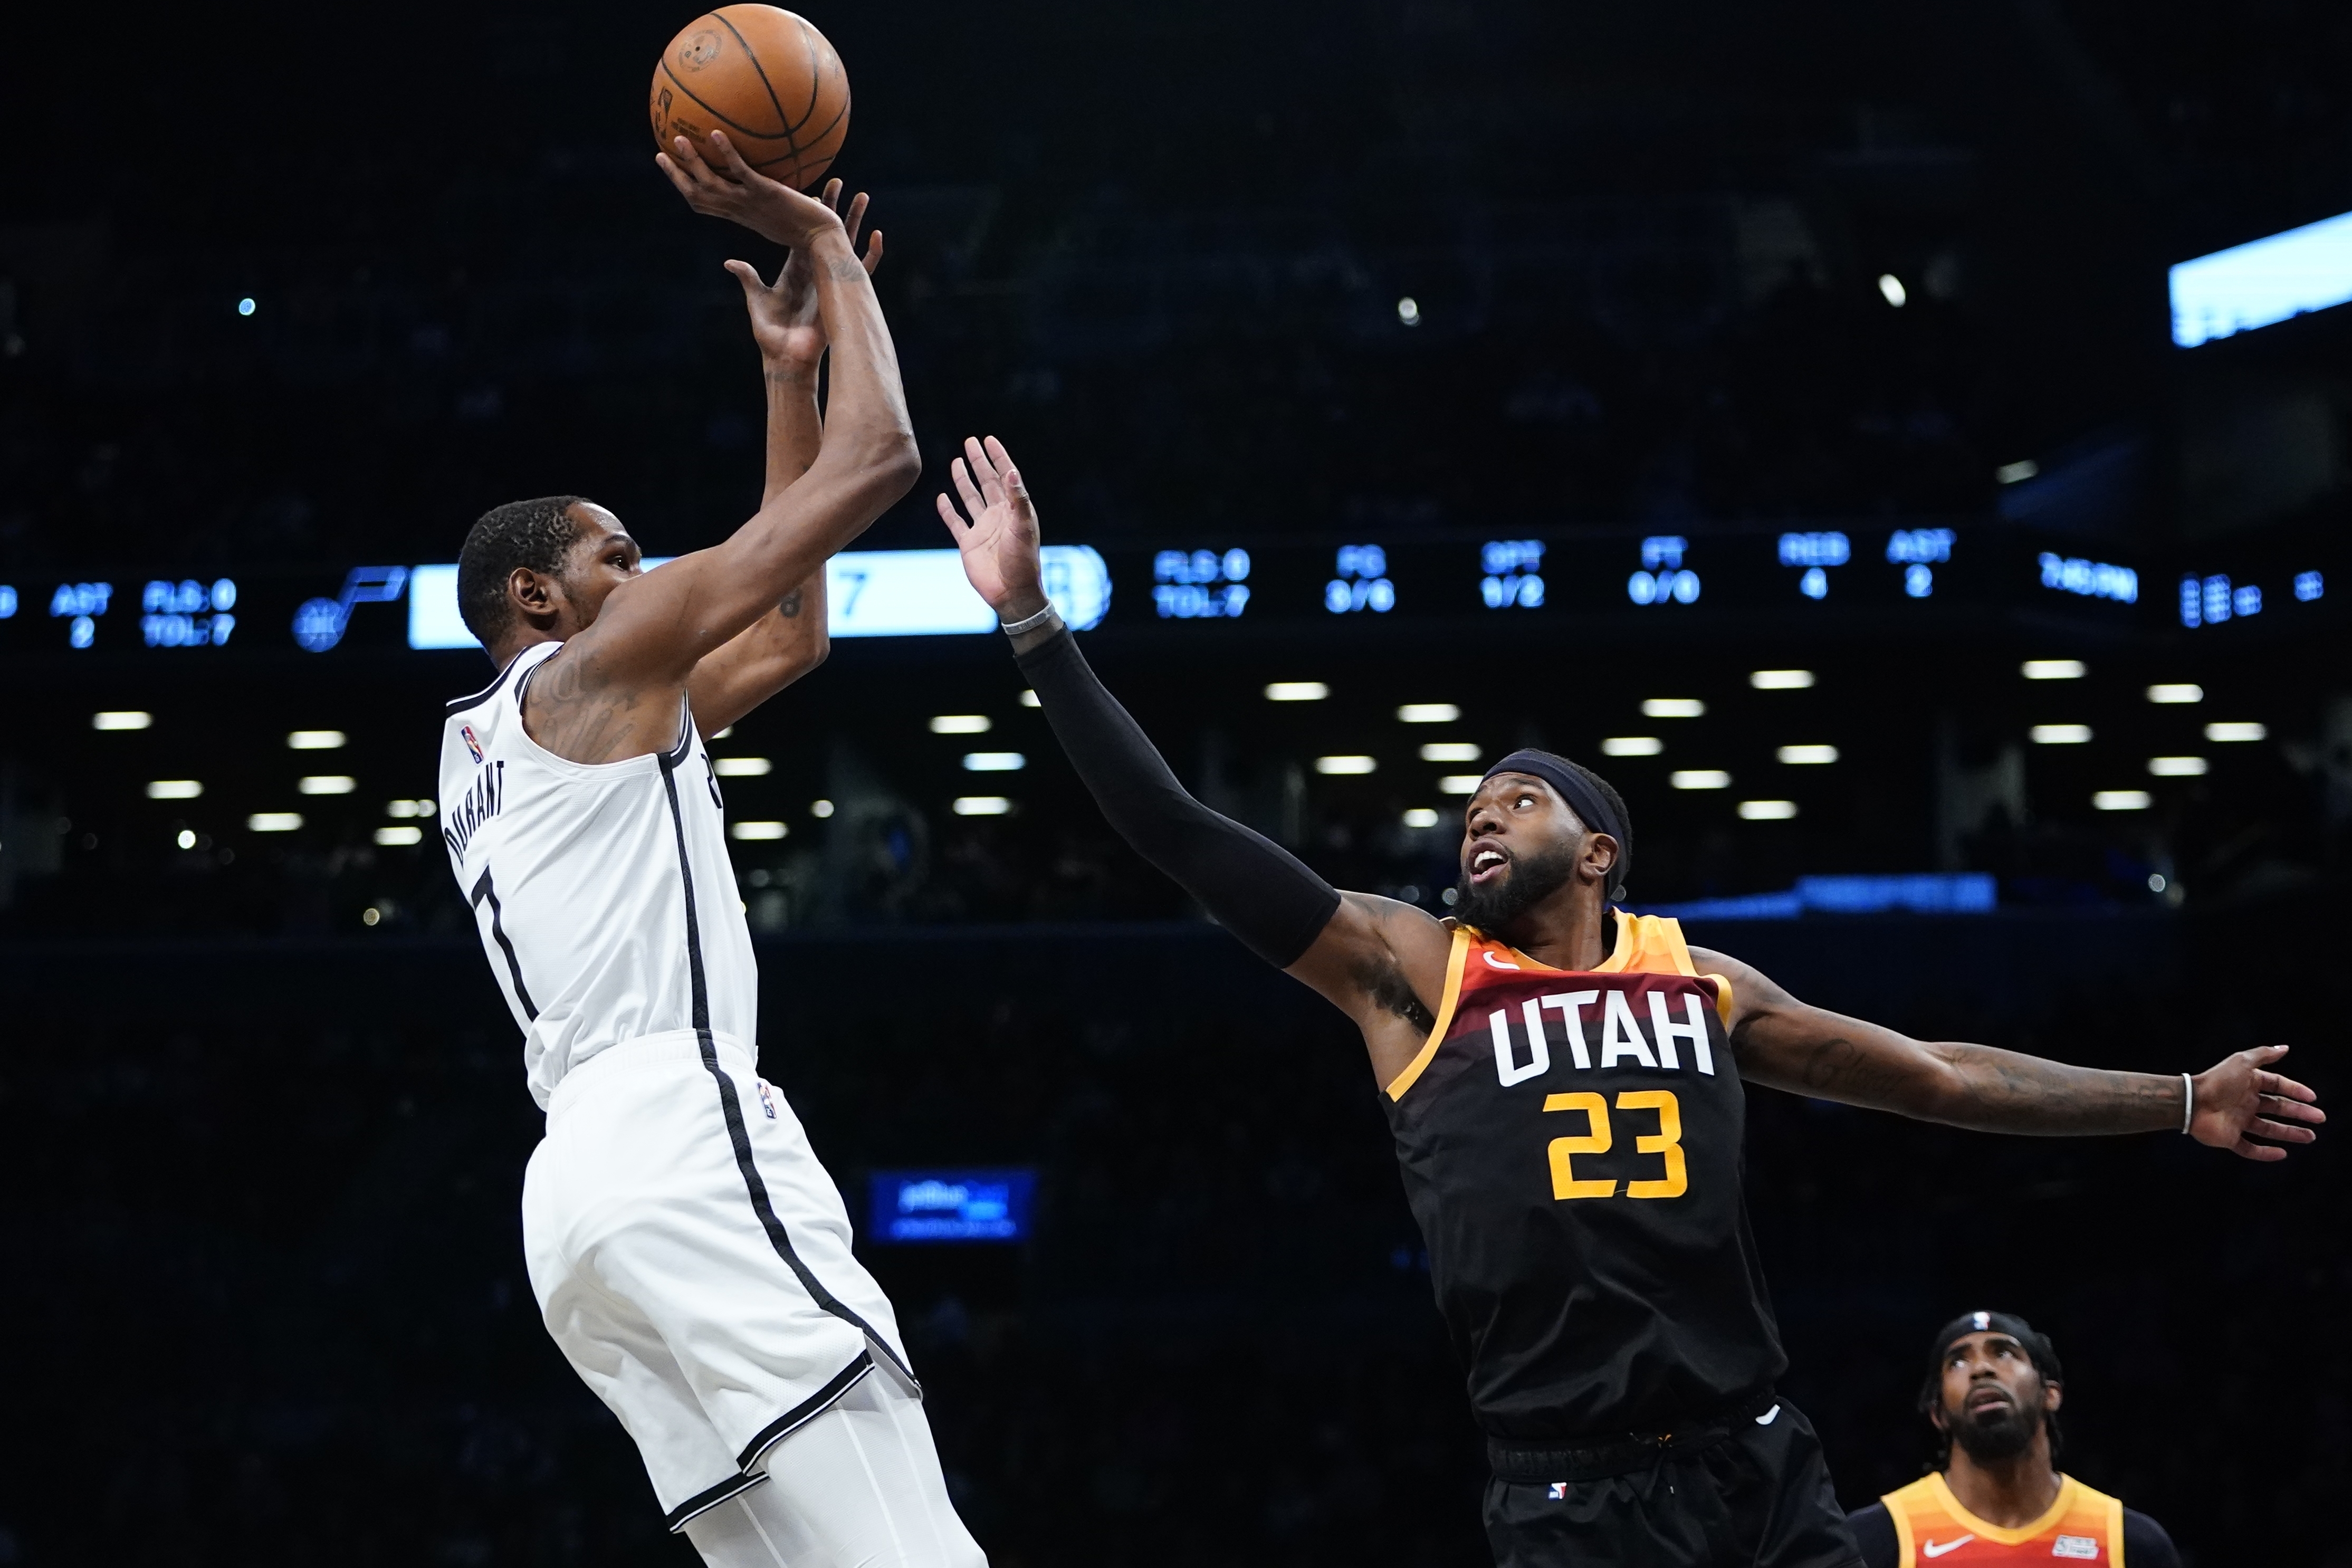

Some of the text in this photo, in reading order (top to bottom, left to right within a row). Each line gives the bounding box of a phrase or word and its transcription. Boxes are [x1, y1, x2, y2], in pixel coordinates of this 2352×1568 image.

[840, 568, 867, 617] 7
[444, 760, 504, 869] DURANT
[471, 864, 540, 1022] 7
[1489, 990, 1715, 1088] UTAH
[1542, 1090, 1688, 1200] 23
